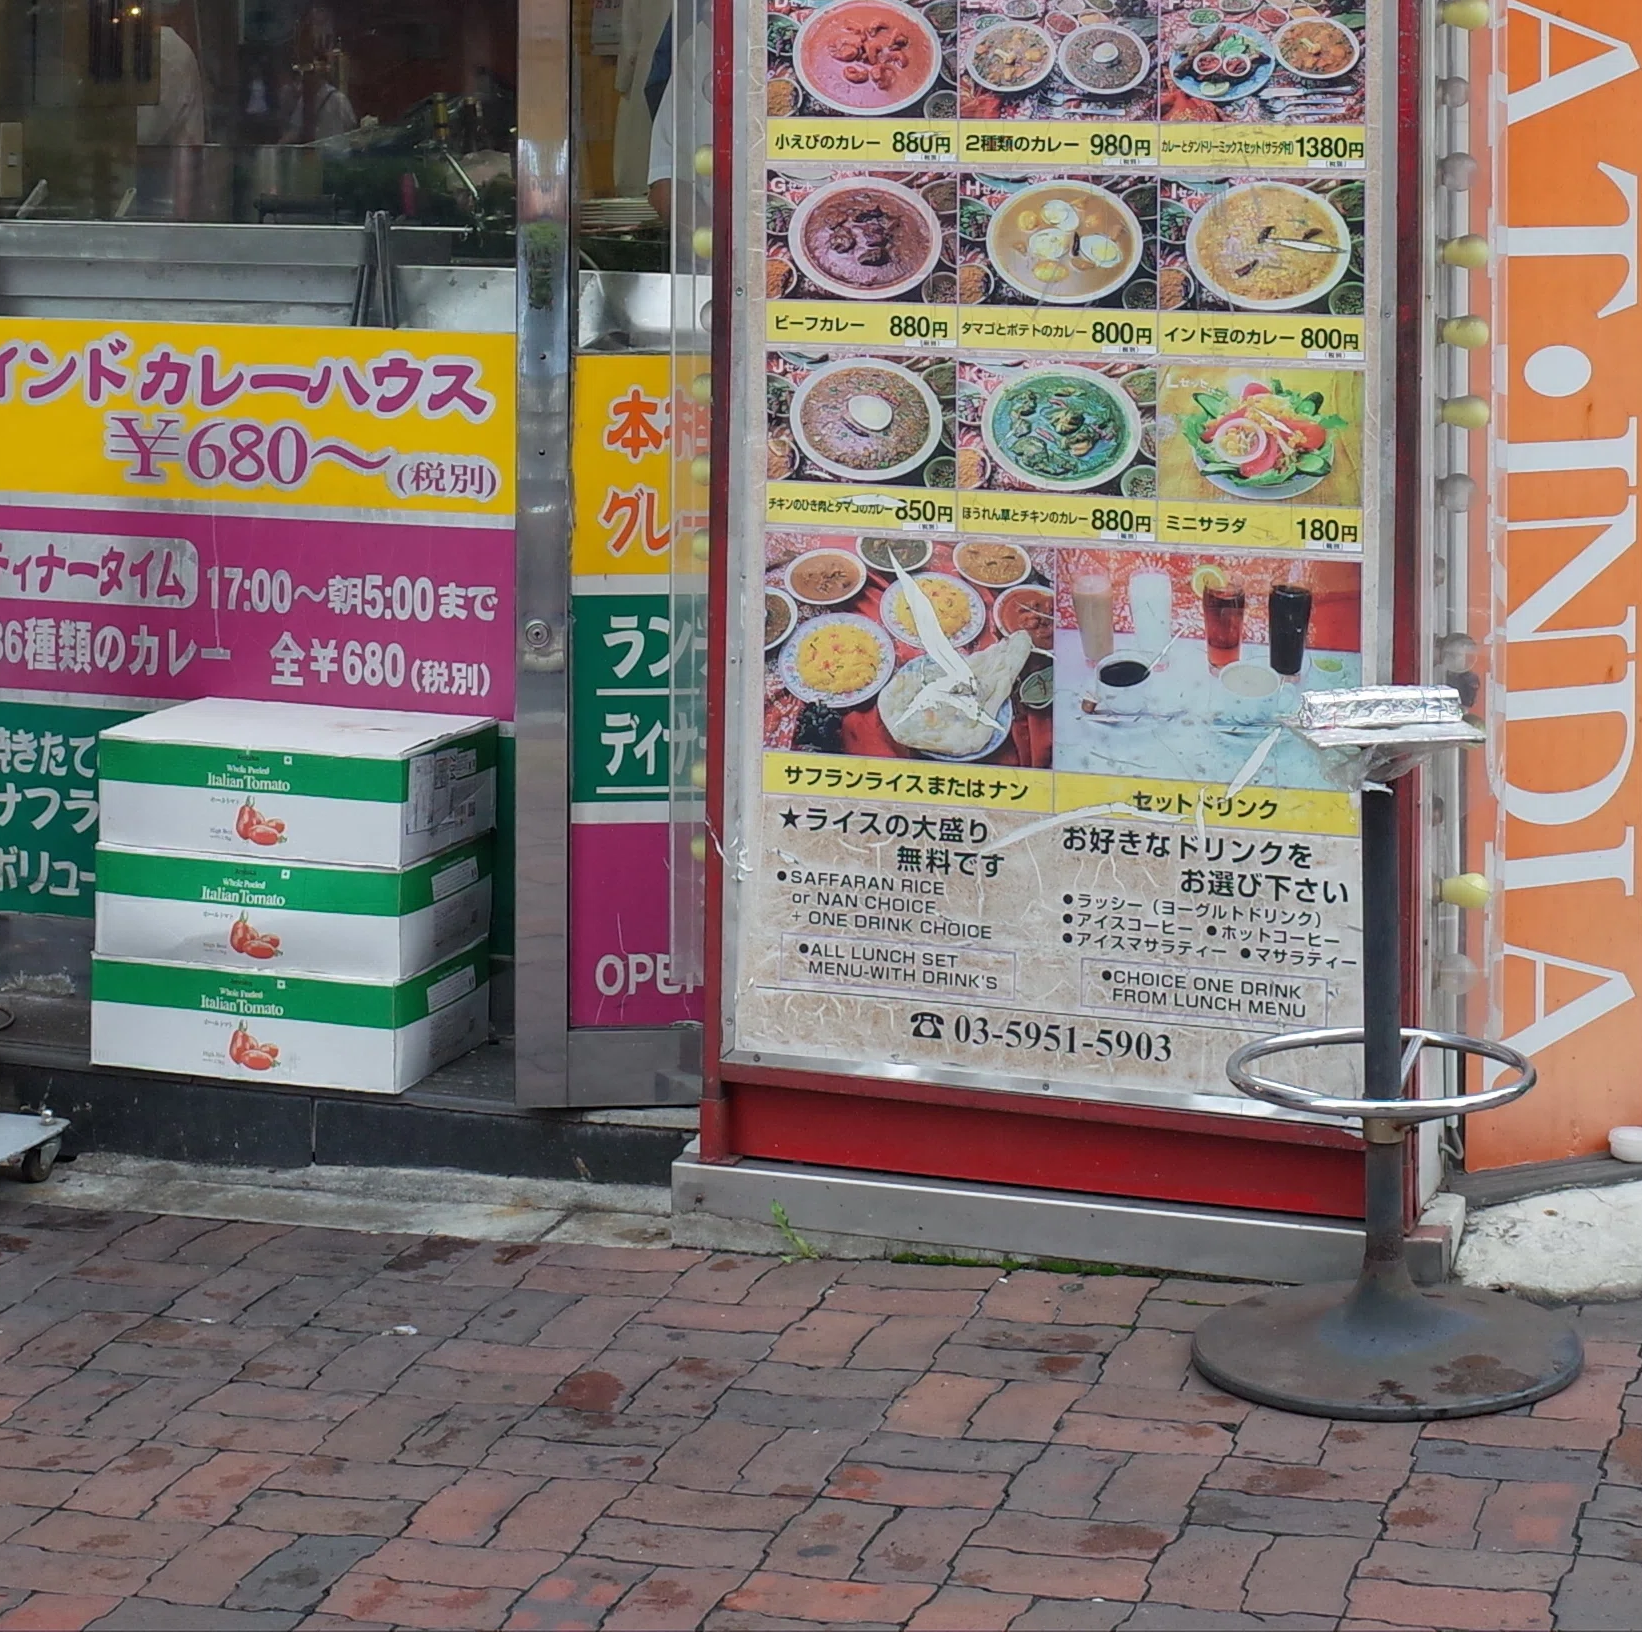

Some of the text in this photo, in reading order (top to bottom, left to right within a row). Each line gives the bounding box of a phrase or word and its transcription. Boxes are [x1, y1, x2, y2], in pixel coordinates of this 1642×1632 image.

[775, 132, 951, 154] 小えびのカレー 880円
[965, 134, 1151, 157] 2種類のカレー 980円
[1295, 137, 1364, 158] 1380円
[775, 316, 947, 338] ビーフカレー 880円
[960, 319, 1152, 345] タマゴとポテトのカレー 800円
[1165, 327, 1358, 350] インド豆のカレー 800円
[895, 499, 953, 522] 850円
[962, 506, 1151, 532] ほうれん草とチキンのカレー 880円
[1166, 516, 1357, 542] ミニサラダ 180円
[208, 772, 290, 791] Italian Tomato
[785, 766, 1028, 800] サフランライスまたはナン
[1133, 791, 1277, 820] セットドリンク
[1063, 826, 1312, 869] お好きなドリンクを
[897, 846, 1005, 877] 無料です
[201, 886, 285, 906] Italian Tomato
[791, 871, 944, 896] SAFFARAN RICE
[1180, 869, 1349, 904] お選び下さい
[792, 891, 936, 914] or NAN CHOICE
[809, 911, 992, 940] ONE DRINK CHOICE
[1077, 913, 1340, 946] アイスコーヒー ホットコーヒー
[811, 944, 959, 968] ALL LUNCH SET
[1077, 933, 1357, 969] アイスマサラティー マサラティー
[808, 961, 998, 990] MENU-WITH DRINK'S
[1114, 970, 1302, 999] CHOICE ONE DRINK
[201, 995, 284, 1015] Italian Tomato
[1112, 988, 1306, 1018] FROM LUNCH MENU
[953, 1015, 1173, 1064] 03-5951-5903
